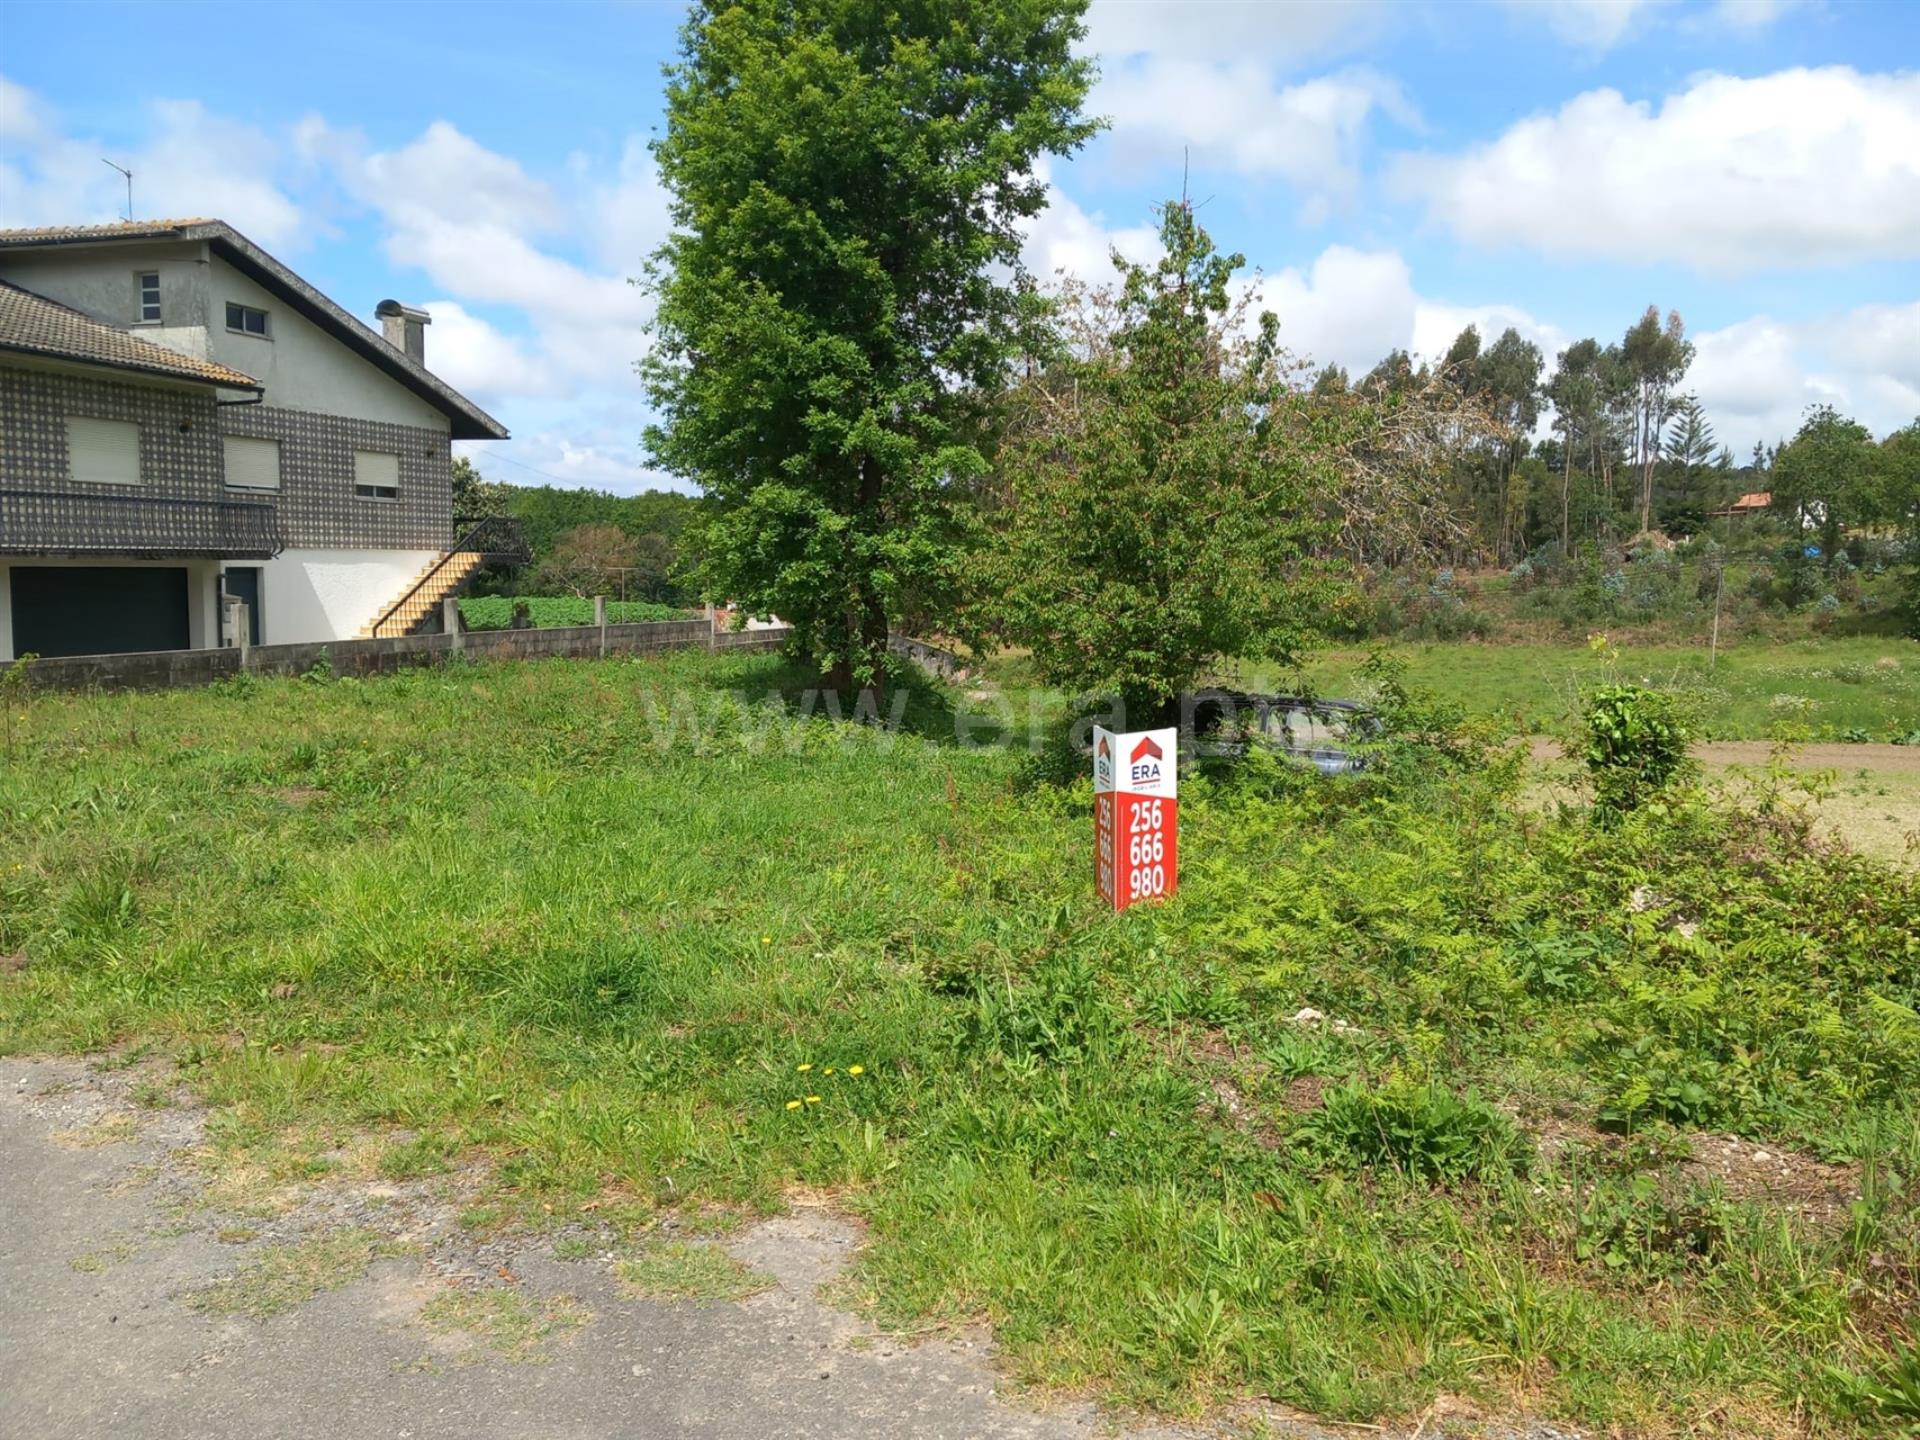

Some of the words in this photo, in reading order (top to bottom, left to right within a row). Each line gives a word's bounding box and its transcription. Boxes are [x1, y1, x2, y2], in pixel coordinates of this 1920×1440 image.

[1131, 764, 1161, 780] ERA
[1130, 799, 1162, 833] 256
[1130, 832, 1164, 866] 666
[1130, 865, 1164, 899] 980
